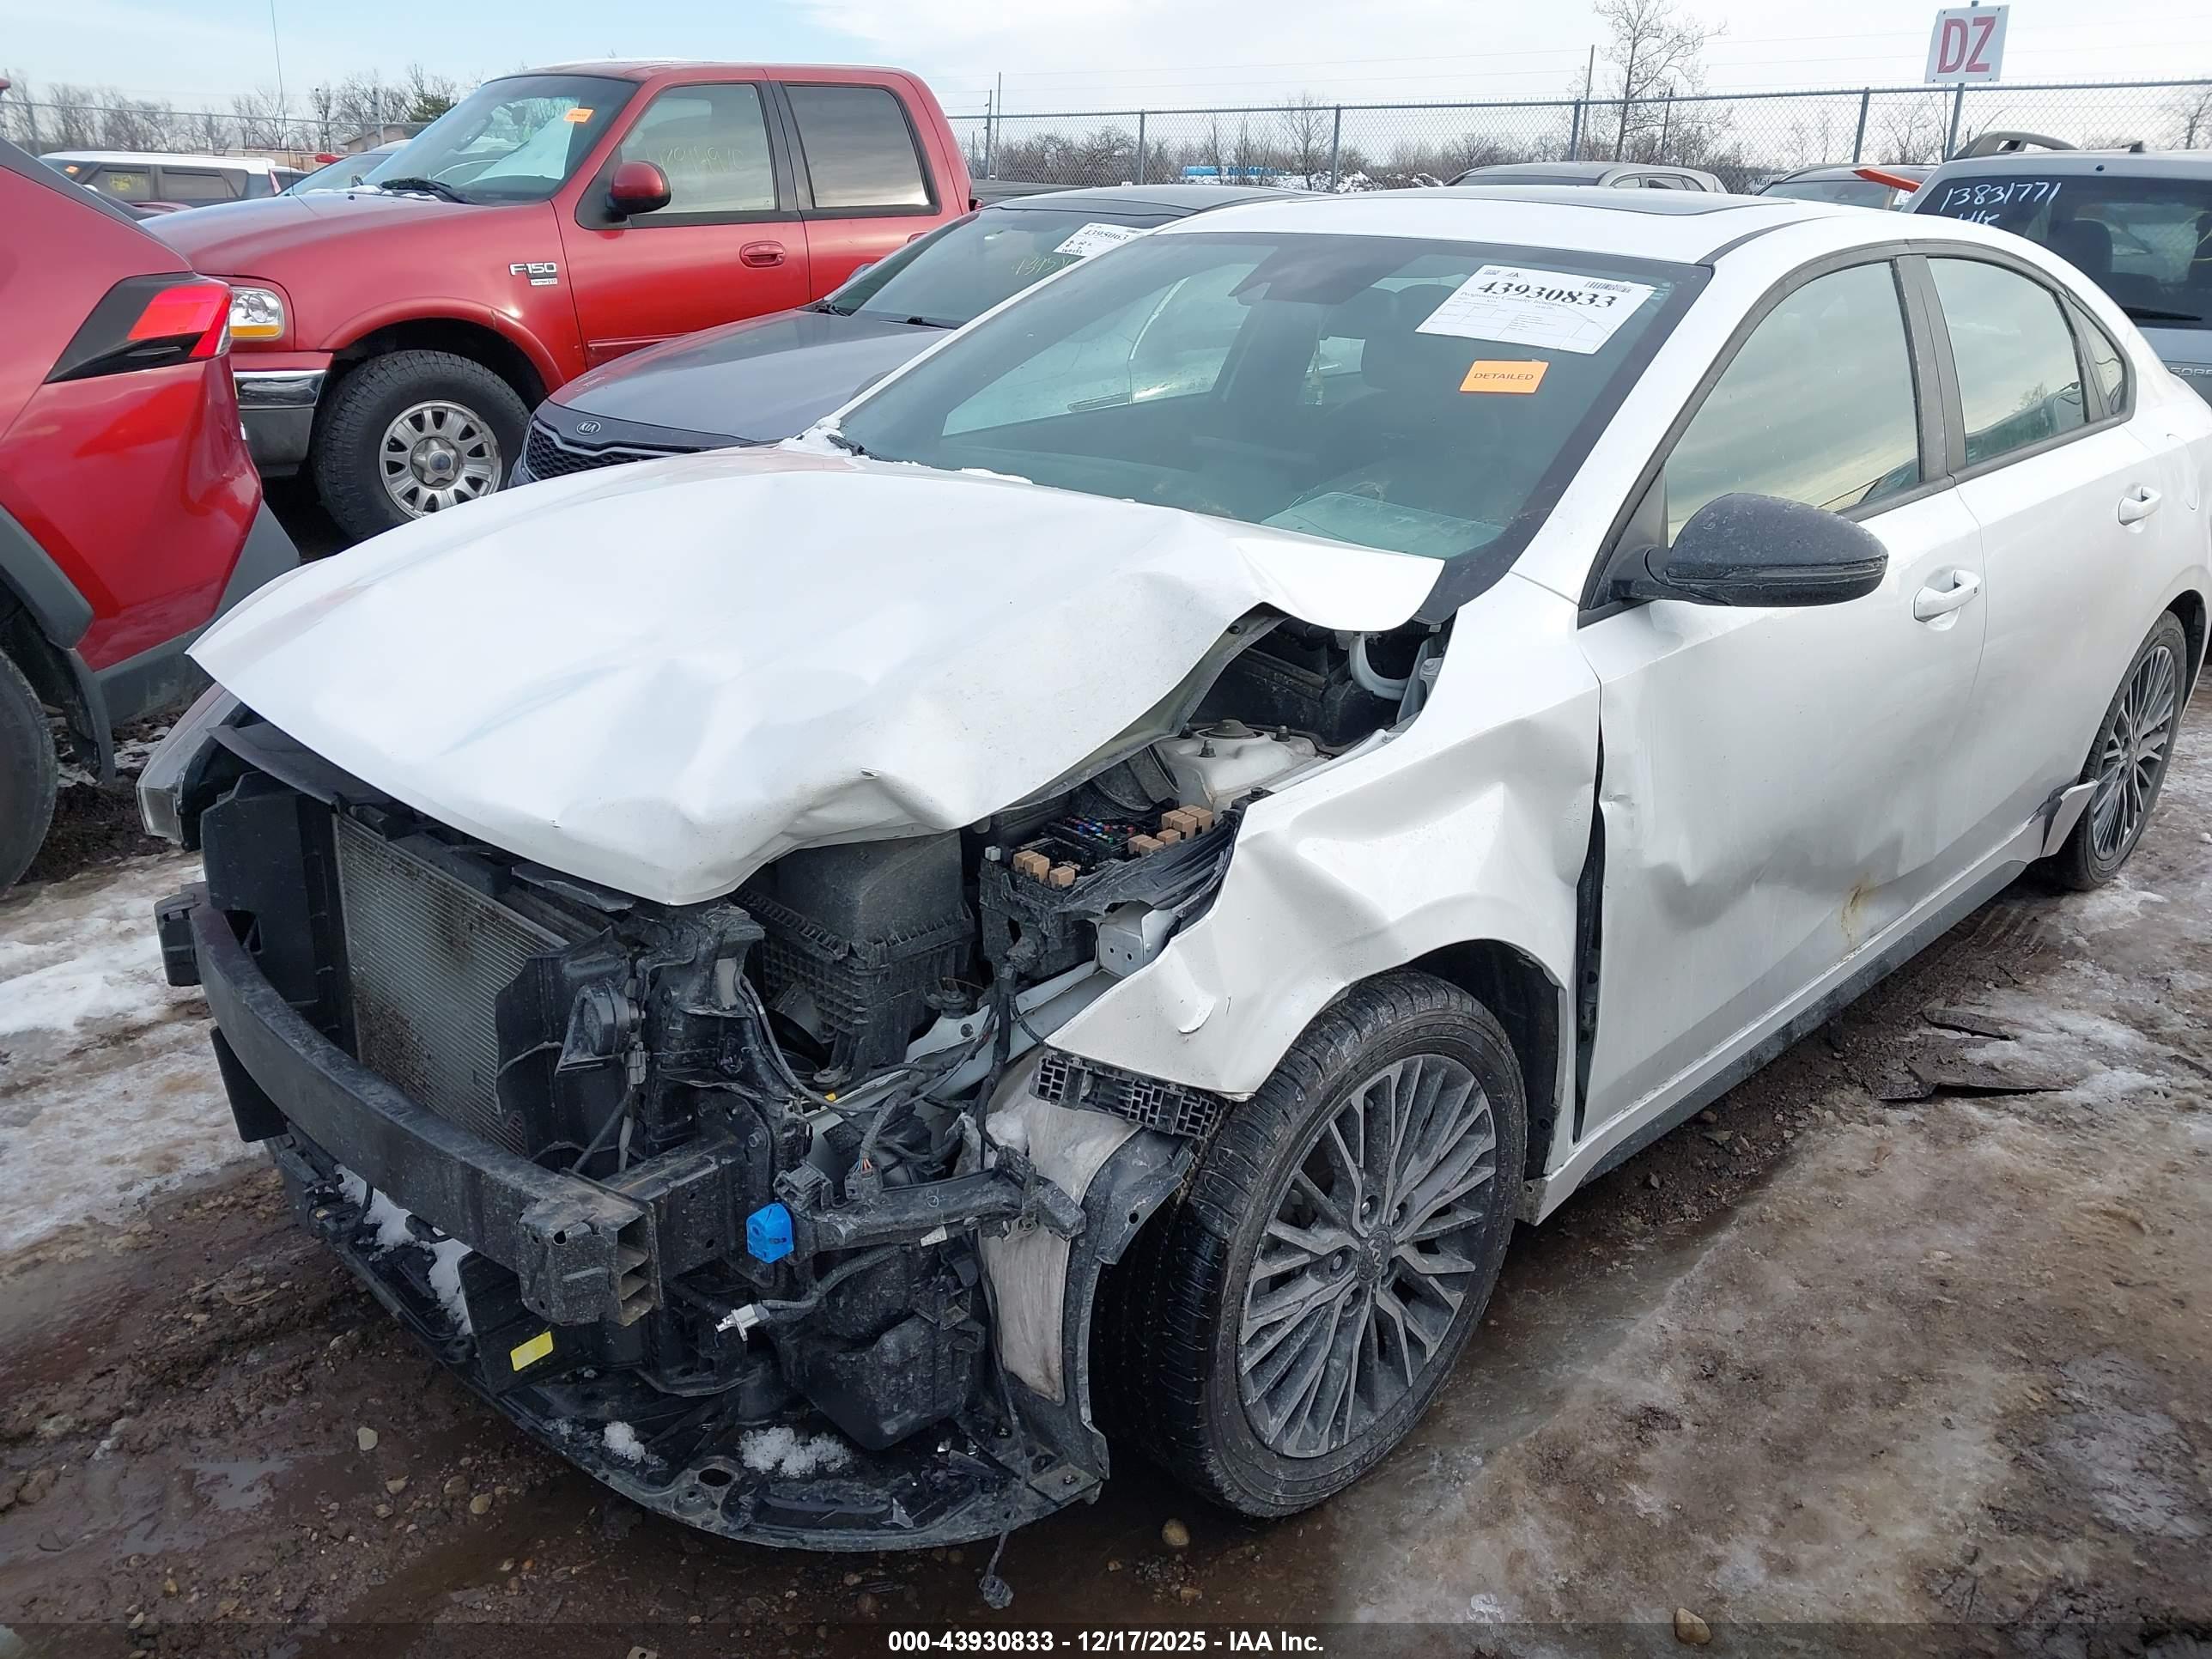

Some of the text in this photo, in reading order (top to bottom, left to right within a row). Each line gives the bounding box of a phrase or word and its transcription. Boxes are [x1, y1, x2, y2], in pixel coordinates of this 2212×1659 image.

[1936, 15, 1996, 74] DZ
[1940, 181, 2062, 212] 13831771
[1478, 281, 1618, 308] 43930833
[578, 422, 599, 434] KIA
